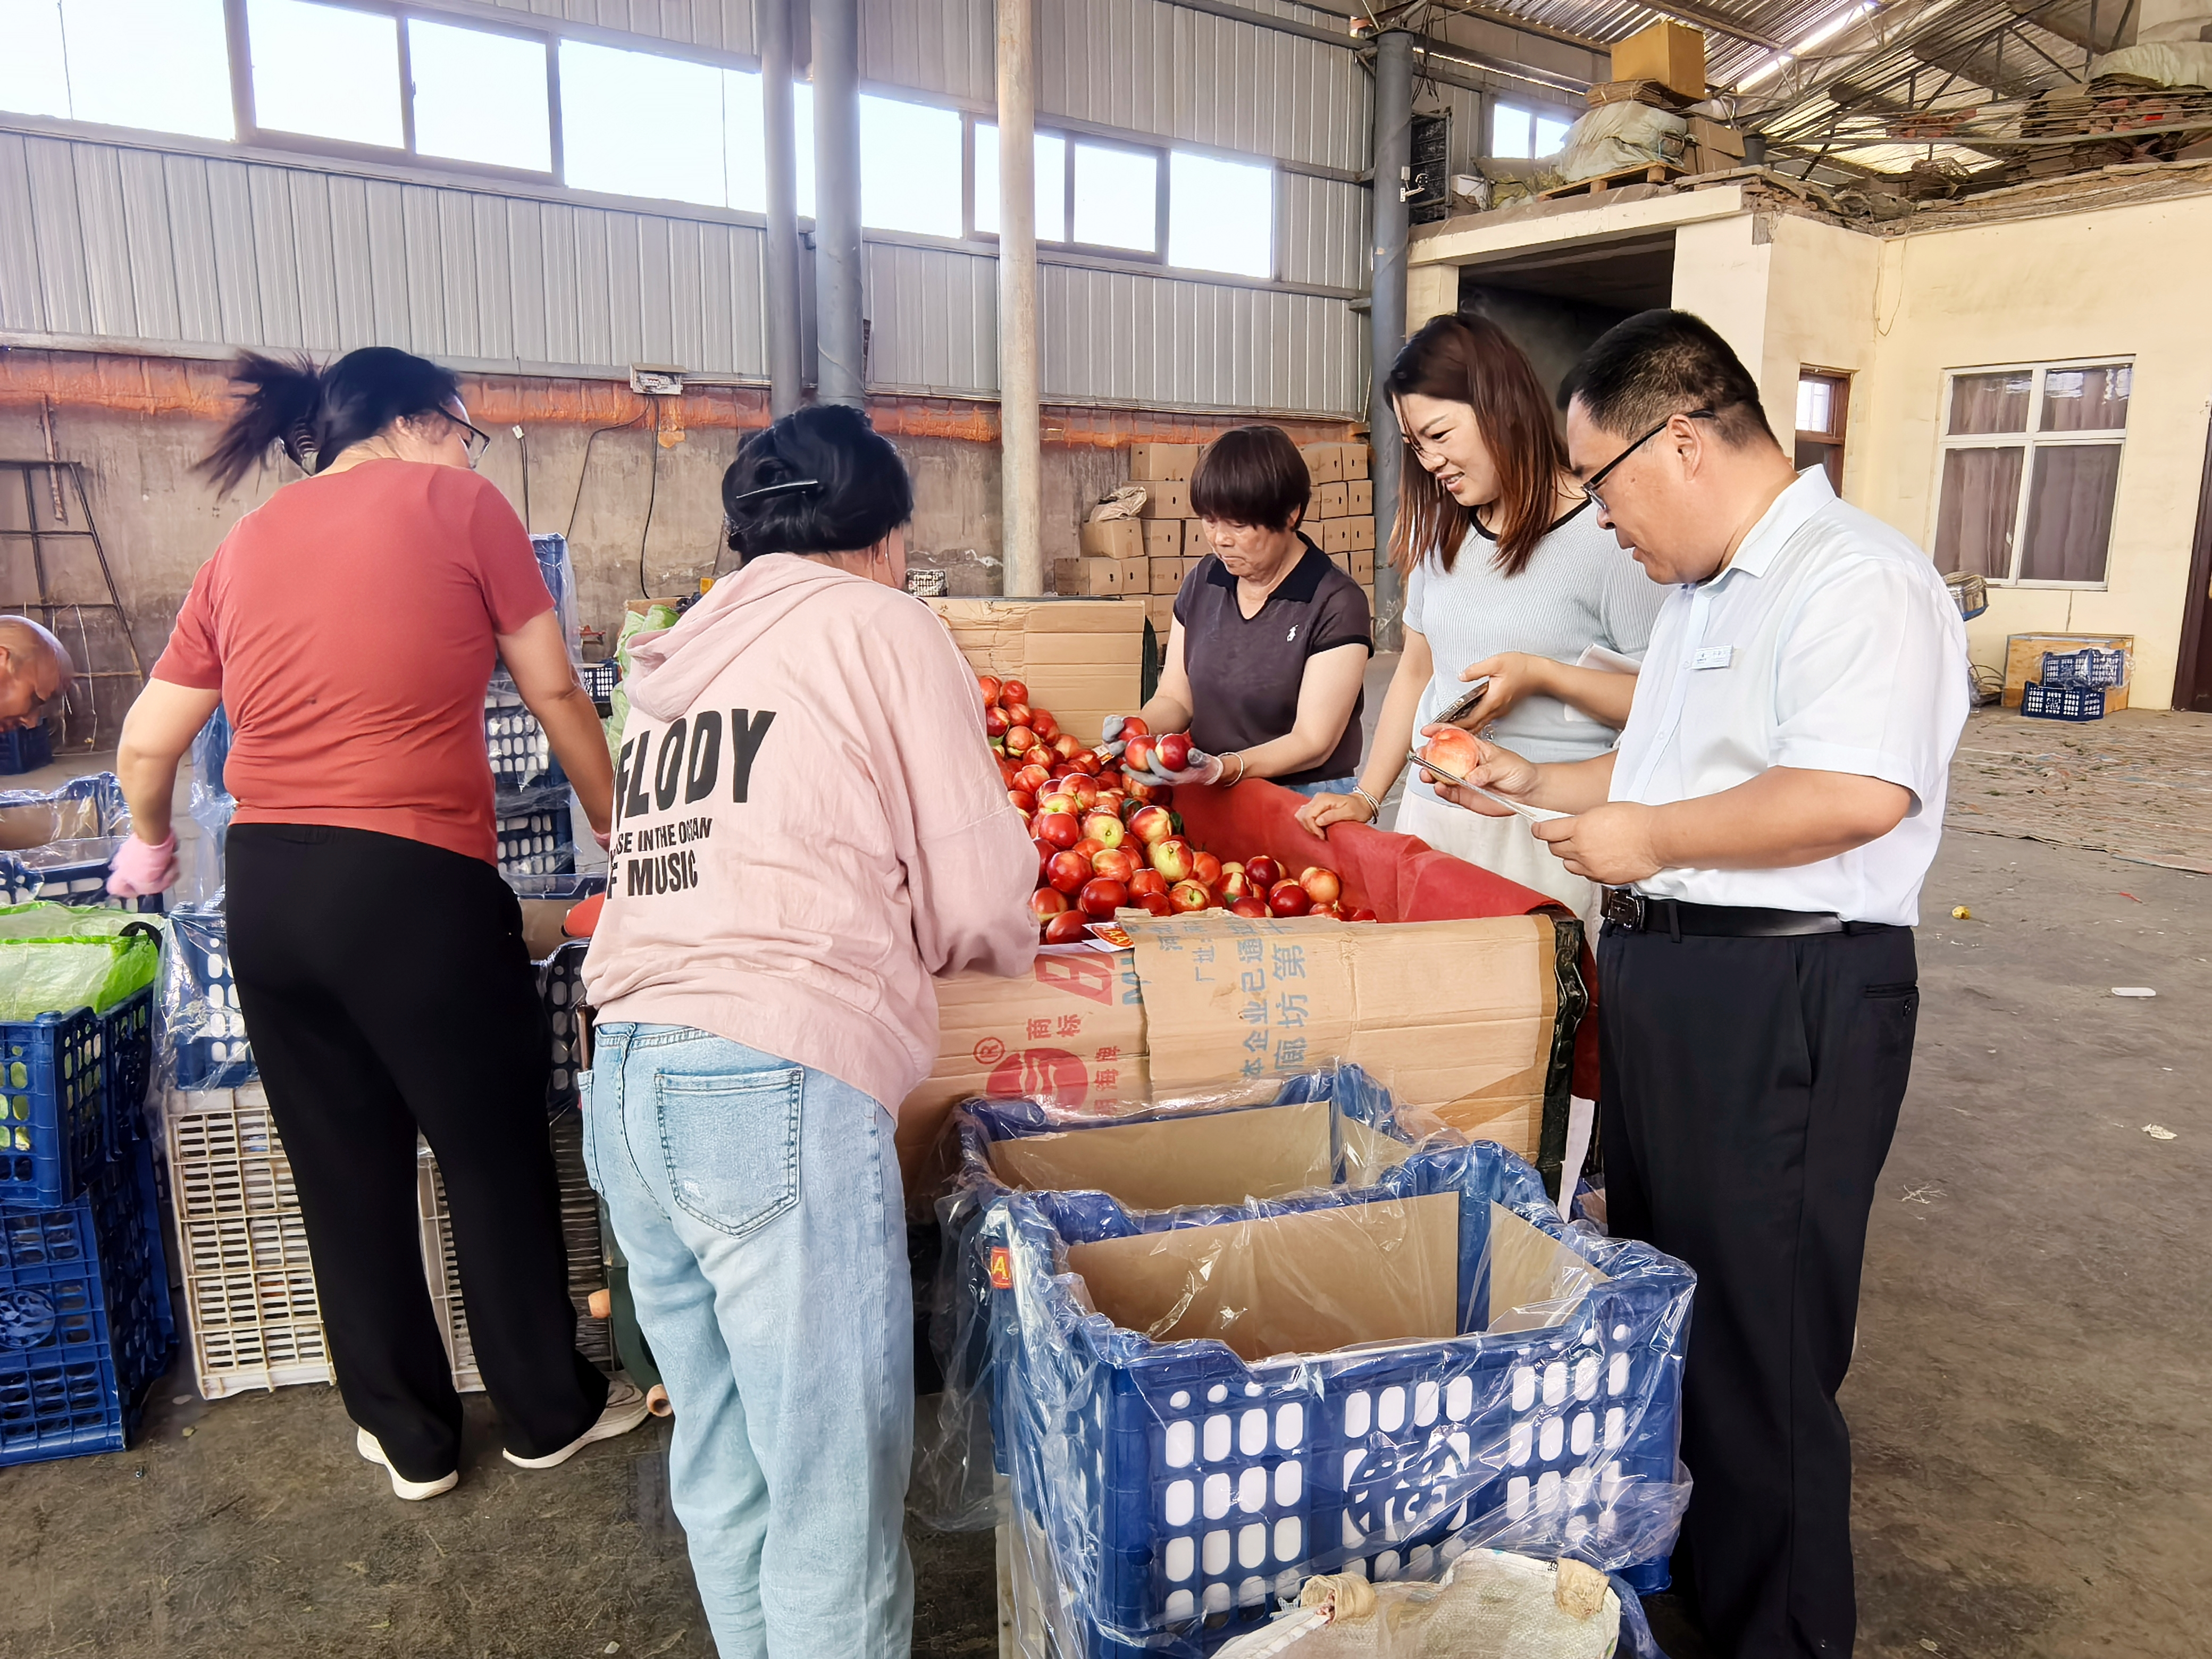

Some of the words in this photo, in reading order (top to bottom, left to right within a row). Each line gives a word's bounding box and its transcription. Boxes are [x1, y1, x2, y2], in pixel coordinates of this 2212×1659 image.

[613, 708, 777, 832] ELODY
[638, 829, 653, 852] IN
[655, 824, 676, 850] THE
[627, 849, 698, 896] MUSIC
[1026, 1013, 1082, 1041] 商标
